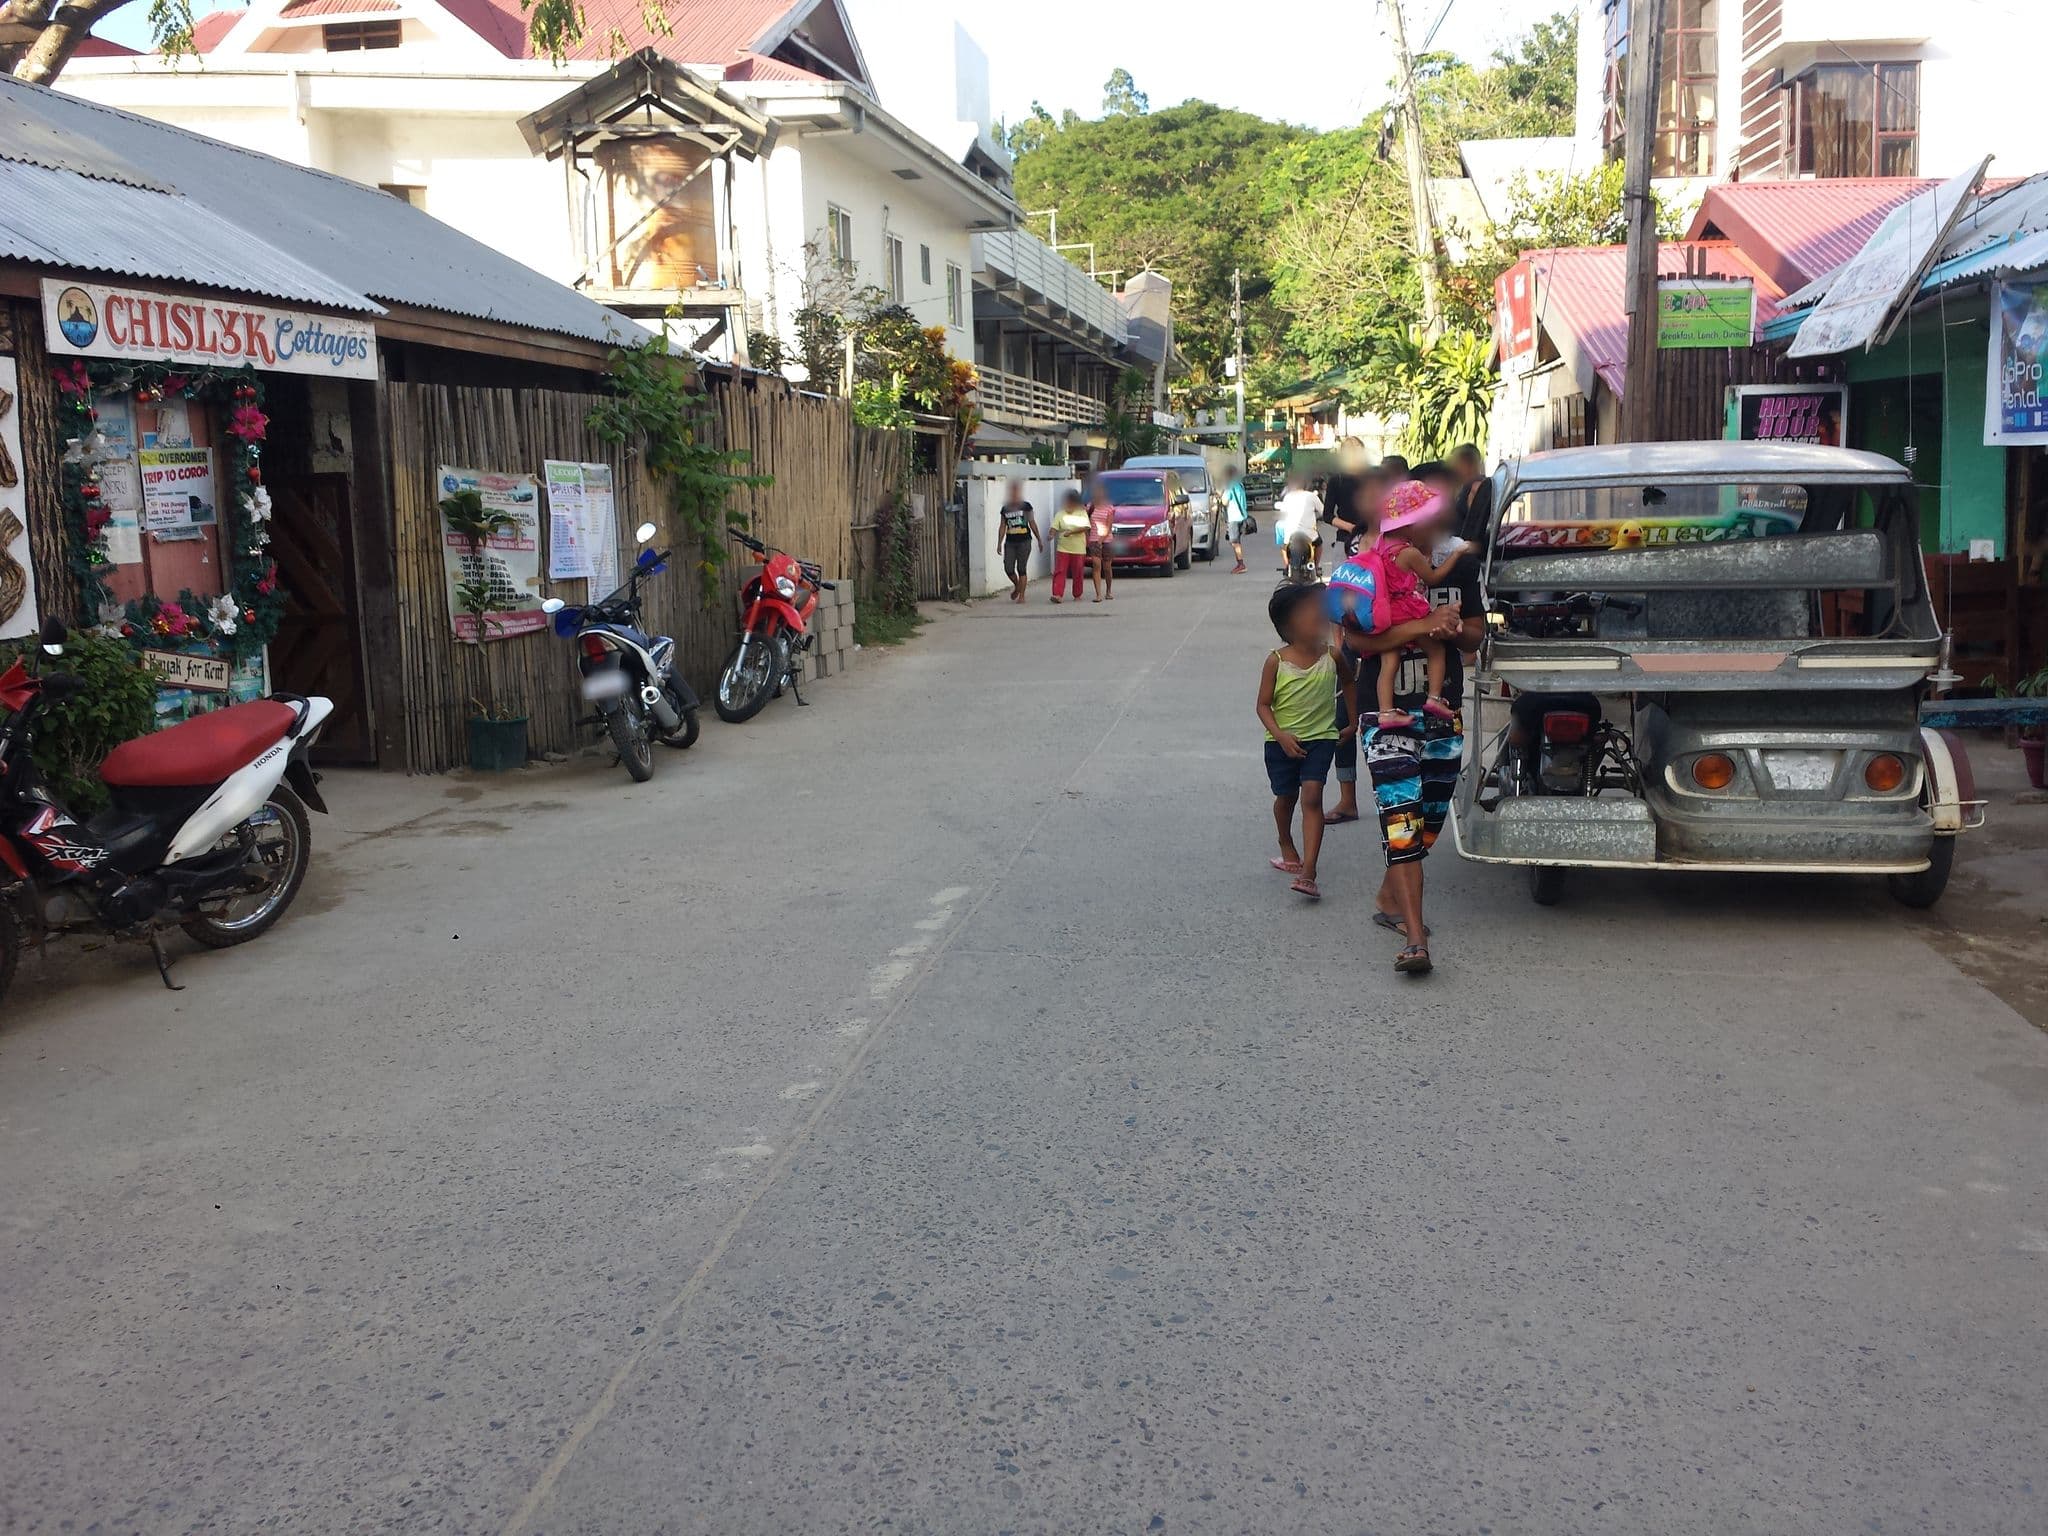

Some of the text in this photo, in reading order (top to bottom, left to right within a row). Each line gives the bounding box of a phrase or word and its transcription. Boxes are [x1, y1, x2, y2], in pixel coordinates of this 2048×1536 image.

[276, 318, 367, 366] Cottages
[2002, 361, 2042, 384] GoPro
[1759, 396, 1824, 417] HAPPY
[2002, 387, 2042, 409] Rental
[1758, 415, 1820, 438] HOUR
[159, 452, 208, 463] OVERCOMER
[144, 465, 209, 485] TRIP TO CORON
[1332, 565, 1372, 585] ANNA
[185, 660, 202, 682] for
[253, 746, 283, 769] HONDA
